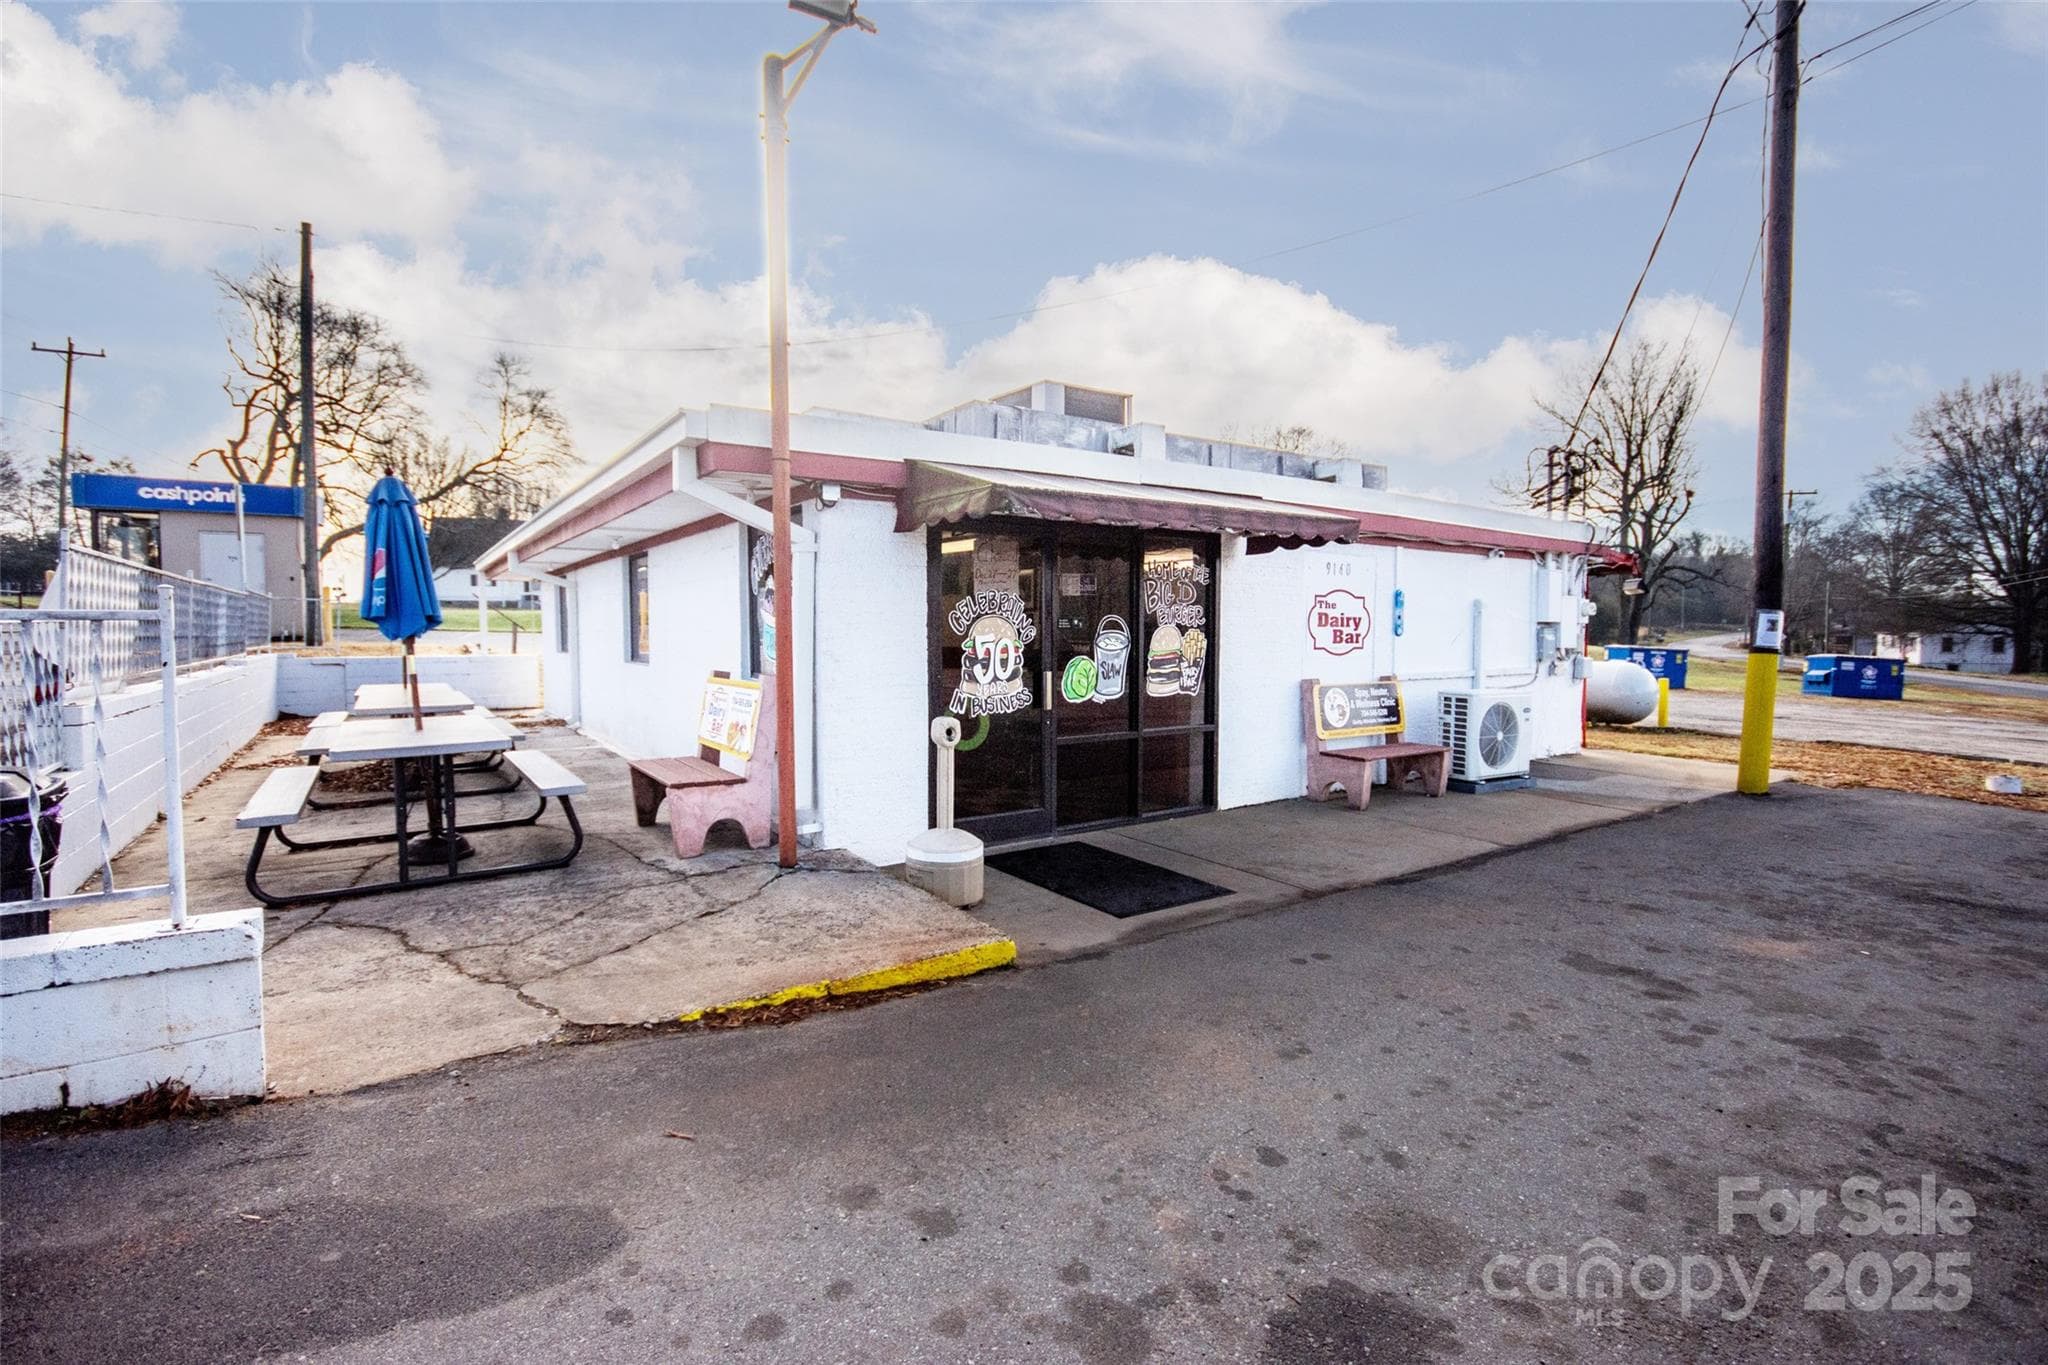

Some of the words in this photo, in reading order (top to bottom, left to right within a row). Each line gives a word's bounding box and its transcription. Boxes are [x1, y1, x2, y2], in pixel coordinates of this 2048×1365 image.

[1147, 560, 1180, 581] HOME
[1143, 578, 1175, 614] BIG
[1176, 579, 1197, 605] D
[1317, 600, 1337, 609] The
[949, 589, 1036, 644] CELEBRATING
[1156, 604, 1207, 627] BURGER
[1317, 612, 1362, 631] Dairy
[1332, 629, 1361, 644] Bar
[973, 633, 1016, 684] 50
[1100, 660, 1121, 680] SLAW
[975, 680, 1009, 697] YEARS
[949, 688, 968, 714] IN
[971, 687, 1033, 718] BUSINESS
